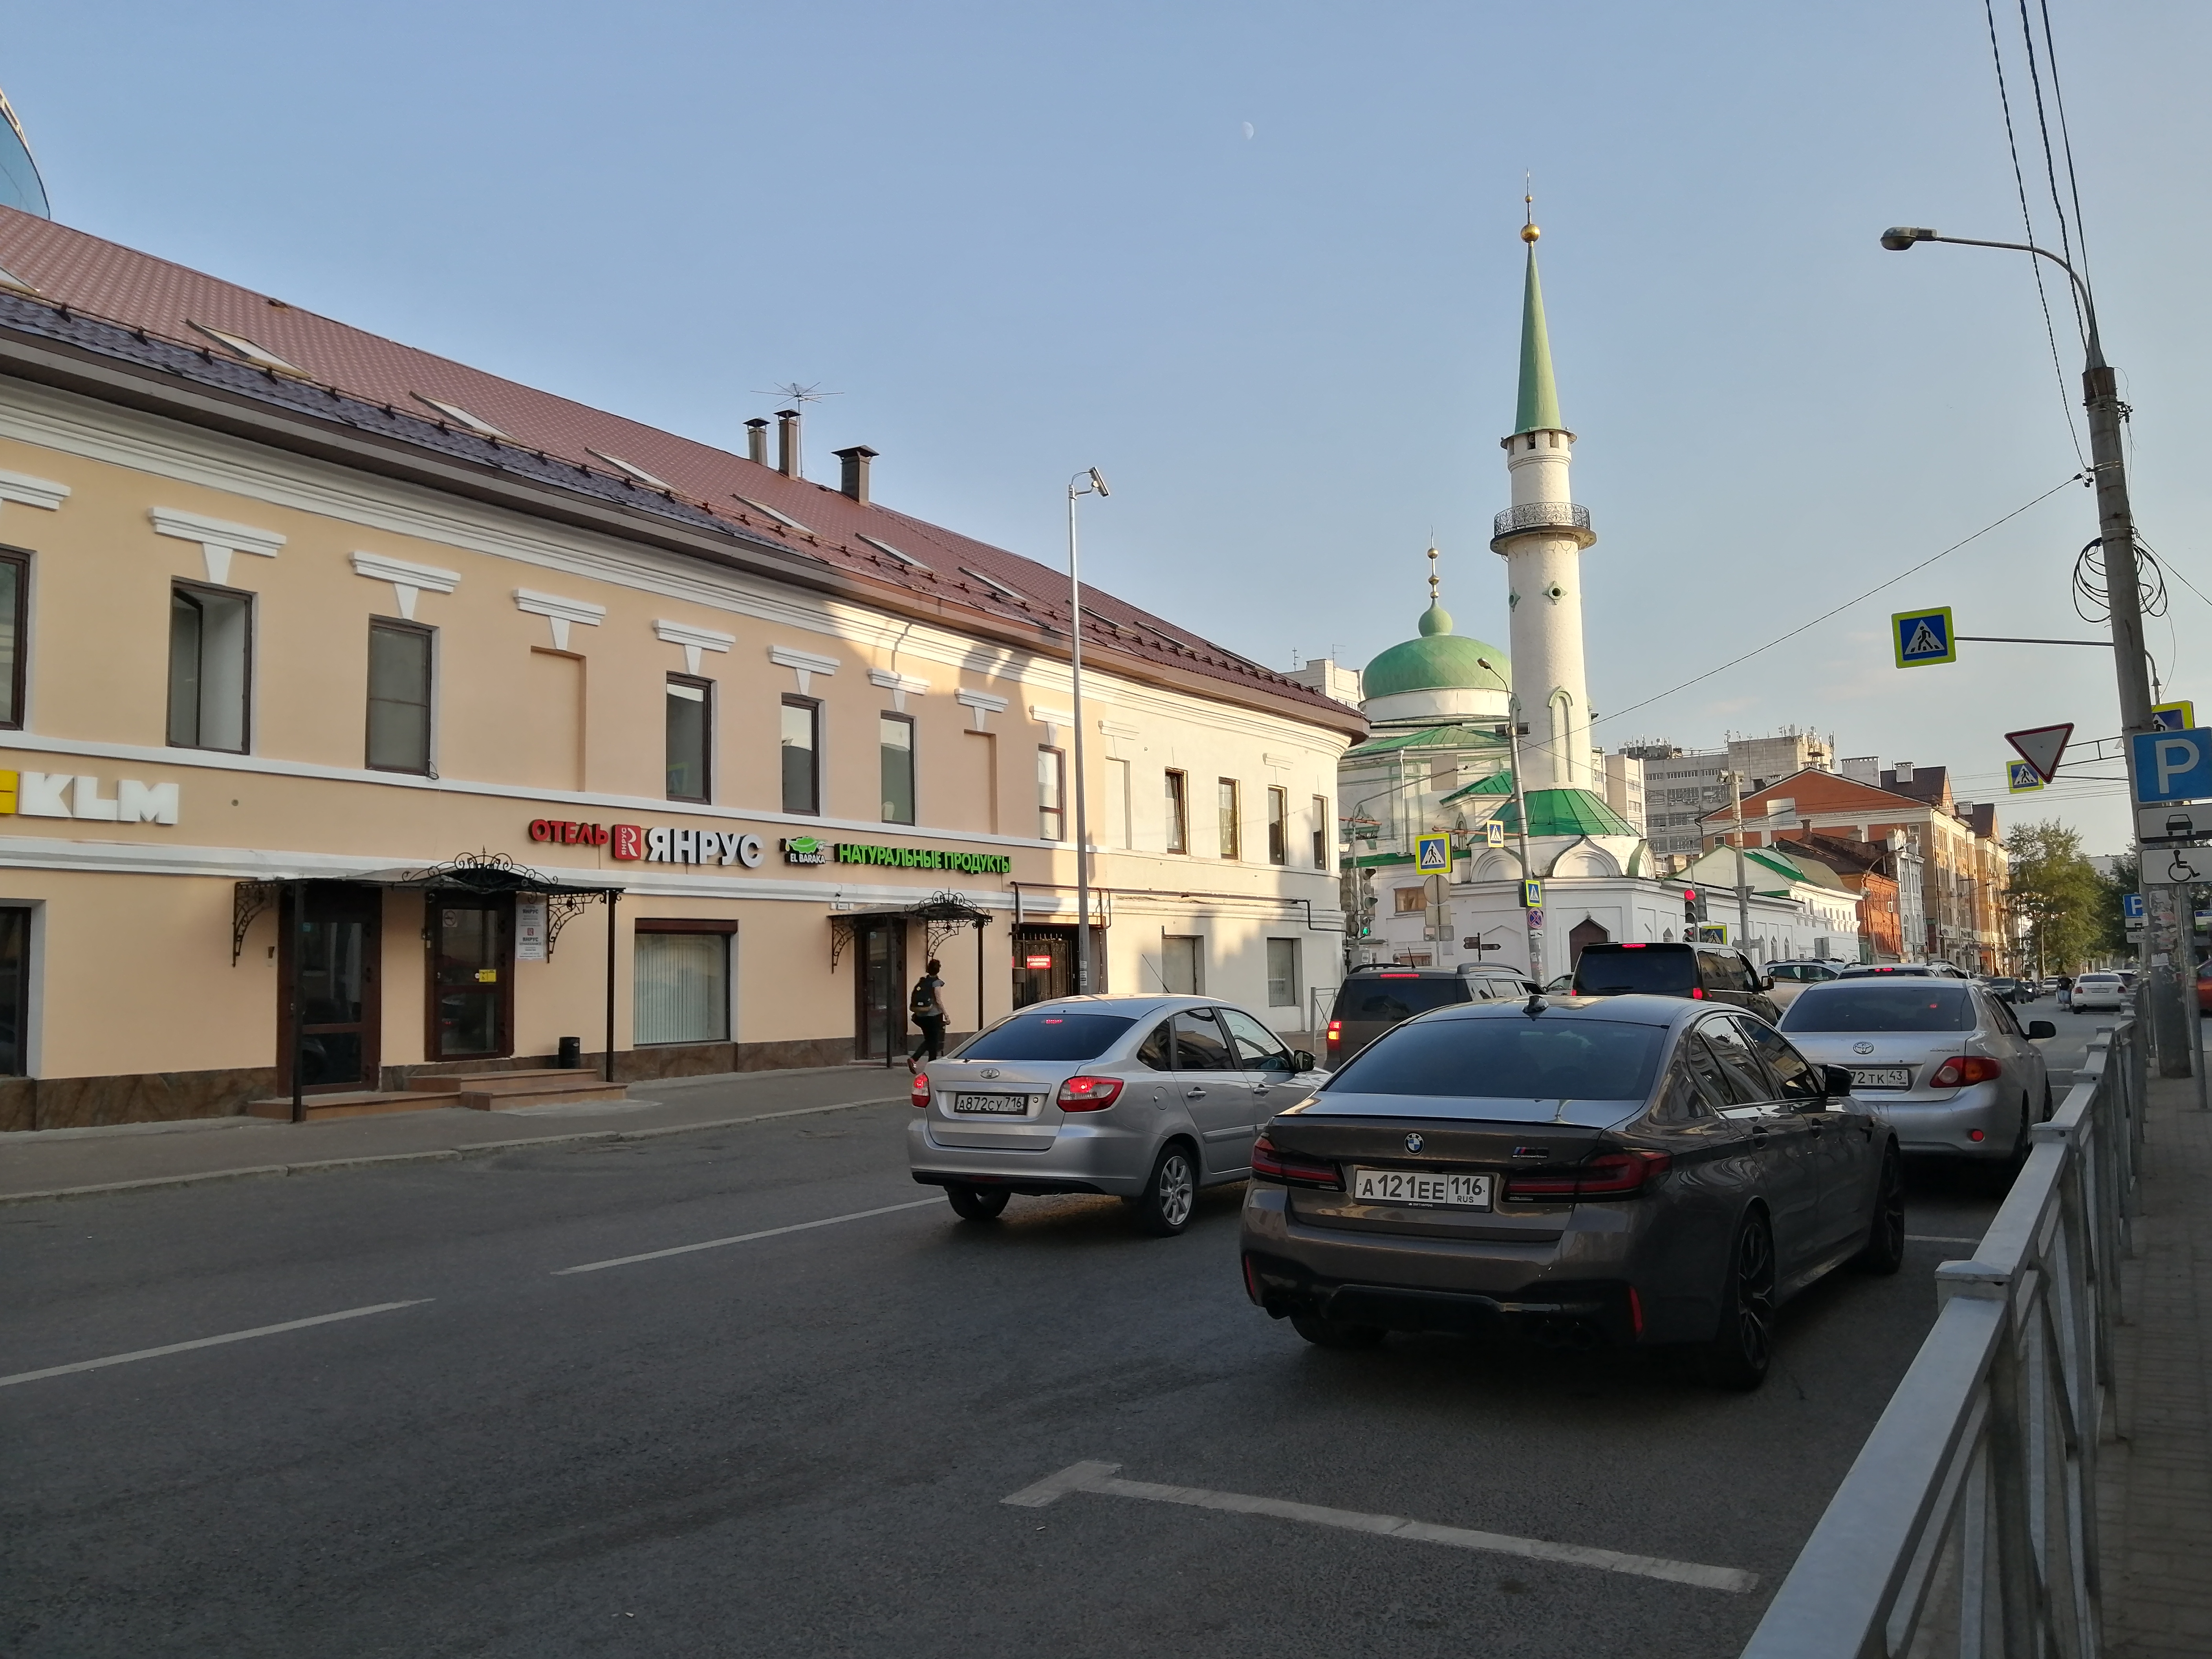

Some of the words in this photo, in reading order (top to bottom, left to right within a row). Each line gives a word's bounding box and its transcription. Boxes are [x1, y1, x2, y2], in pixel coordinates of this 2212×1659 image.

[2155, 738, 2199, 794] P
[20, 771, 179, 824] KLM
[532, 819, 609, 845] ОТЕЛЬ
[648, 827, 764, 868] ЯНРУС
[790, 853, 798, 862] EL
[799, 854, 826, 864] BARAKA
[839, 843, 942, 868] НАТУРАЛЬНЫЕ
[944, 851, 1012, 874] ПРОДУКТЫ
[1889, 1071, 1903, 1080] 43
[1005, 1097, 1022, 1108] 716
[1451, 1177, 1482, 1196] 116
